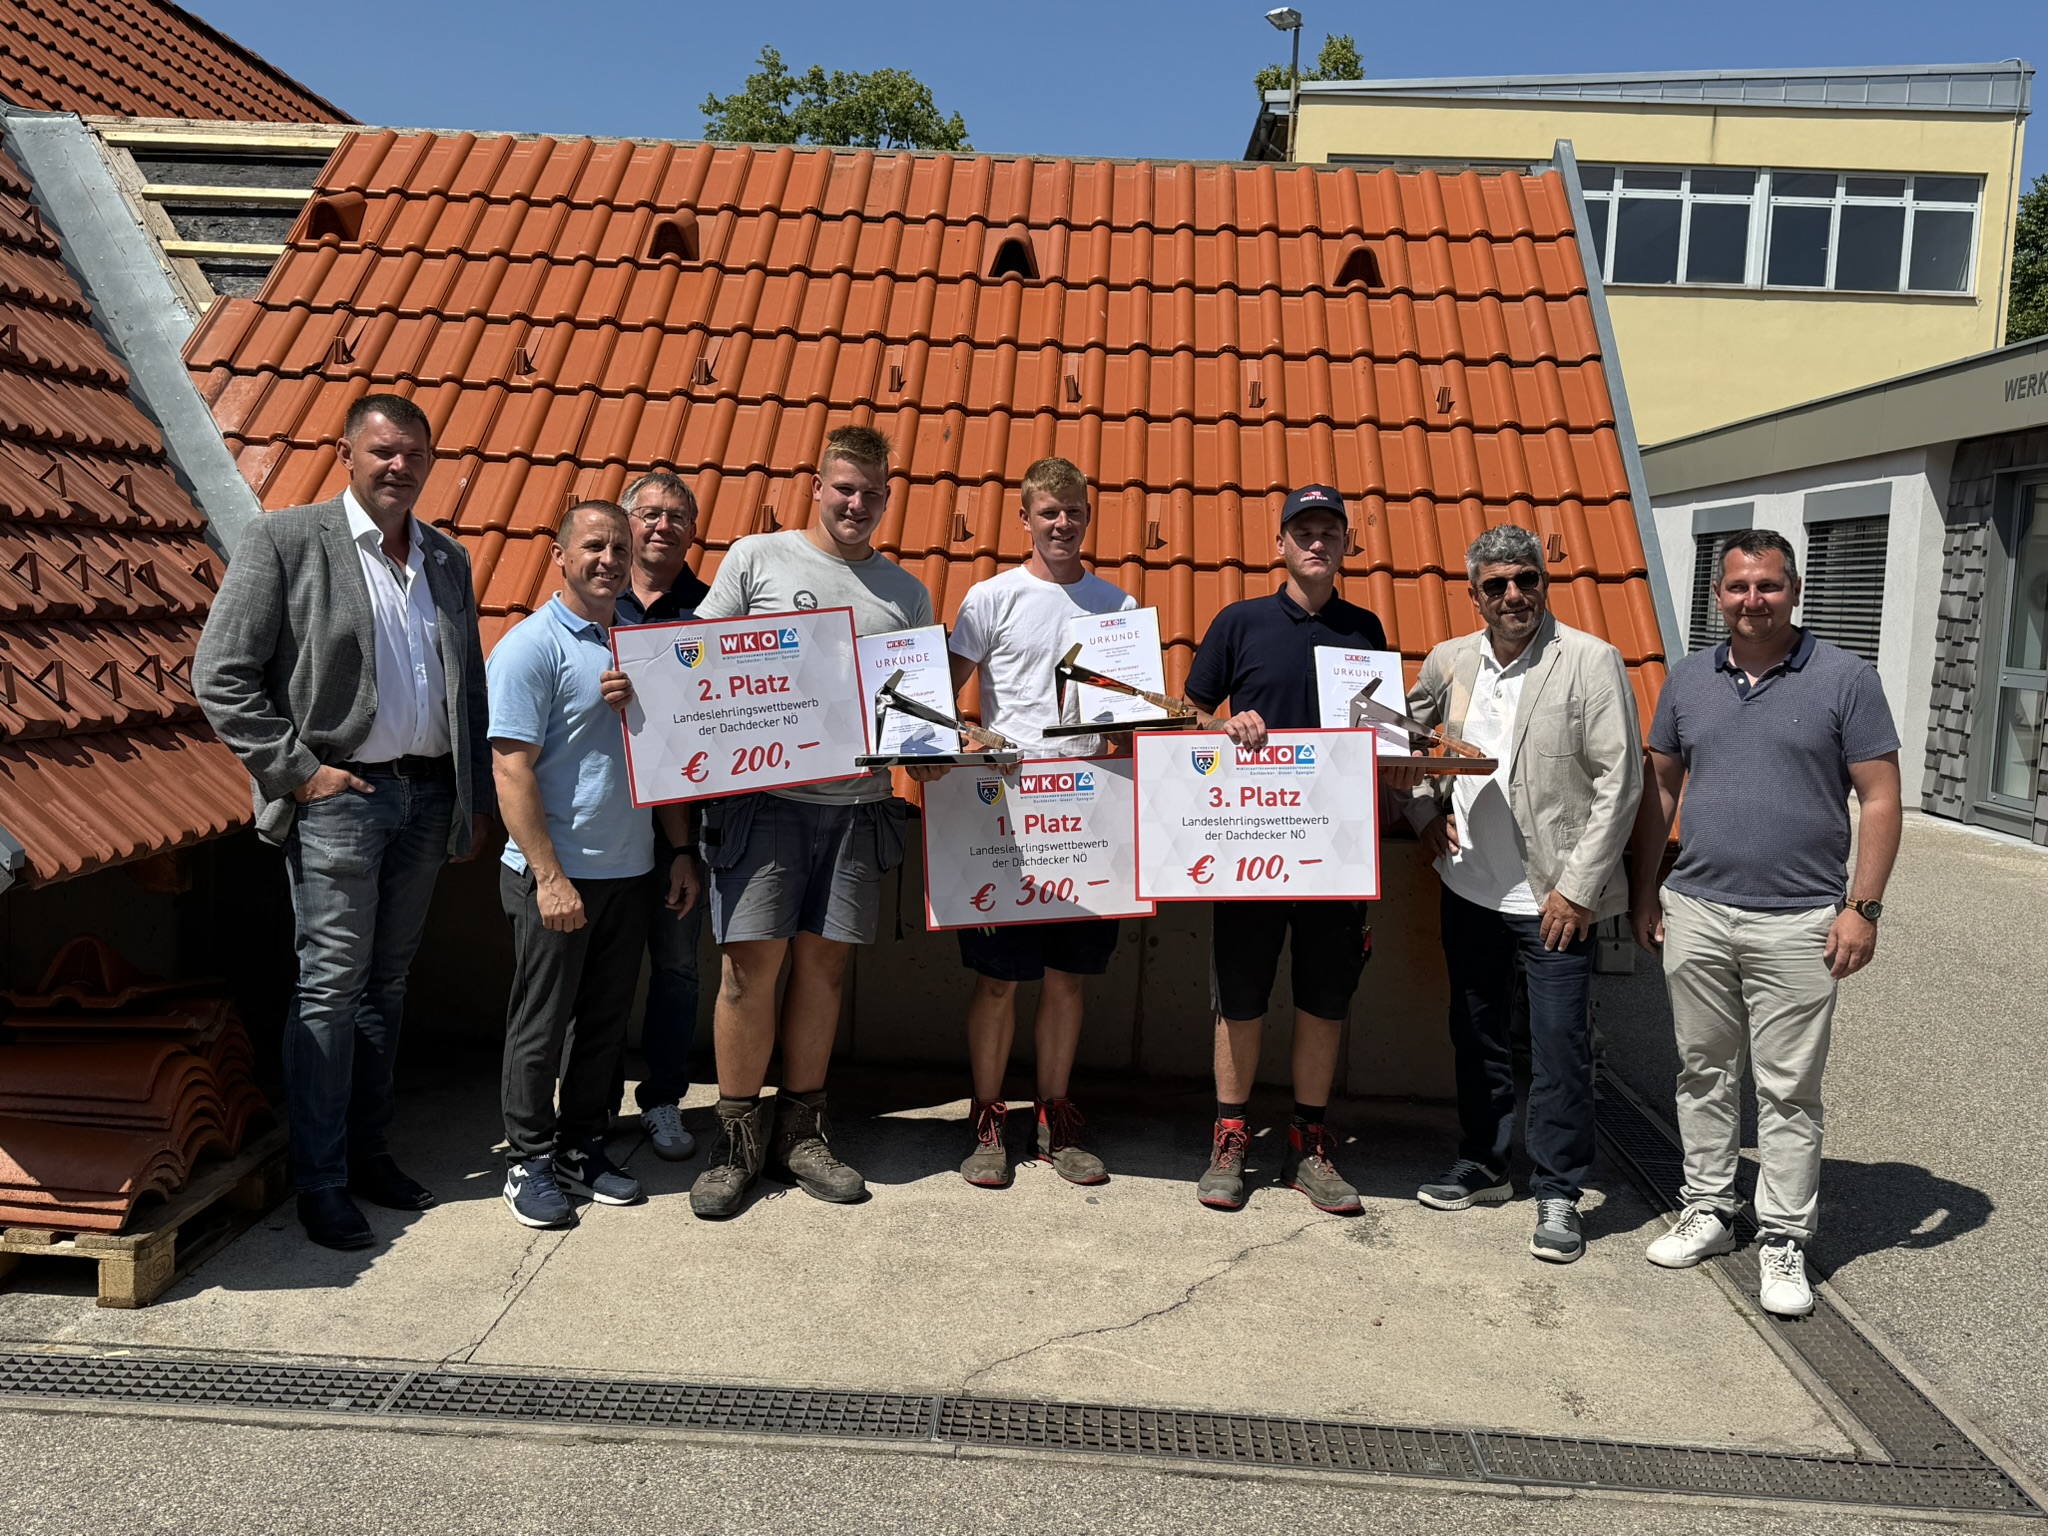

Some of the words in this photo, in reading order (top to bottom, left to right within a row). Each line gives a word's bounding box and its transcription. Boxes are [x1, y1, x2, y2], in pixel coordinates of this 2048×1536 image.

[2004, 370, 2048, 402] WERK
[720, 631, 777, 653] WKO
[886, 639, 907, 649] WKO
[1089, 630, 1141, 645] URKUNDE
[875, 652, 930, 668] URKUNDE
[1333, 667, 1384, 678] URKUNDE
[698, 679, 721, 701] 2.
[728, 674, 790, 698] Platz
[673, 697, 819, 723] Landeslehrlingswettbewerb
[698, 725, 717, 736] der
[719, 718, 780, 734] Dachdecker
[783, 712, 799, 726] NÖ
[1236, 747, 1292, 763] WKO
[680, 751, 709, 783] €
[1020, 775, 1073, 792] WKO
[1208, 786, 1231, 808] 3.
[1240, 786, 1301, 807] Platz
[997, 816, 1015, 836] 1.
[1024, 813, 1082, 835] Platz
[1182, 815, 1329, 828] Landeslehrlingswettbewerb
[1205, 831, 1223, 840] der
[1226, 830, 1287, 840] Dachdecker
[1290, 828, 1306, 839] NÖ
[969, 839, 1109, 856] Landeslehrlingswettbewerb
[992, 859, 1009, 868] der
[1012, 855, 1070, 867] Dachdecker
[1073, 851, 1088, 863] NÖ
[1186, 854, 1215, 884] €
[969, 882, 997, 912] €
